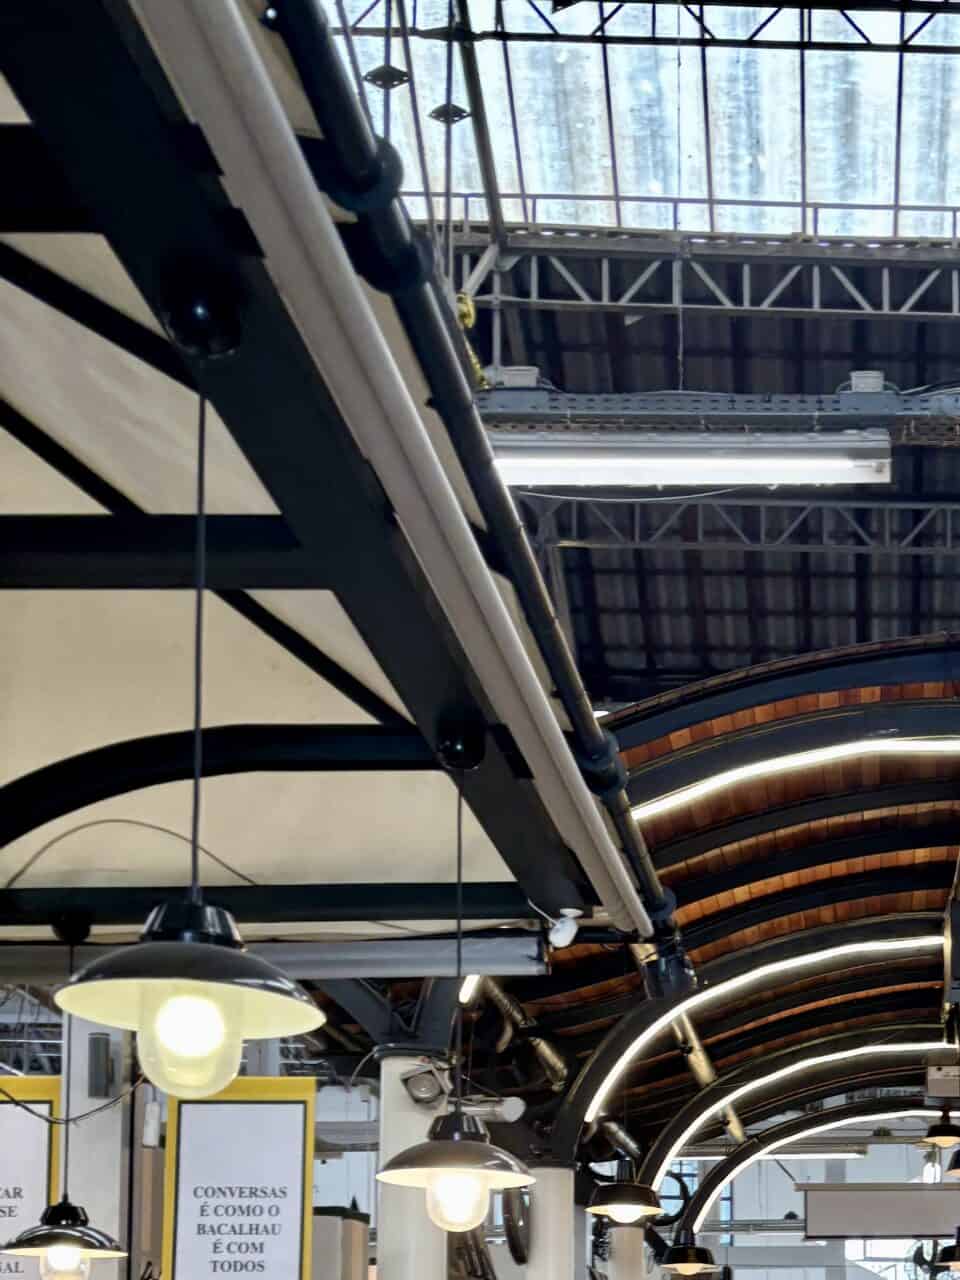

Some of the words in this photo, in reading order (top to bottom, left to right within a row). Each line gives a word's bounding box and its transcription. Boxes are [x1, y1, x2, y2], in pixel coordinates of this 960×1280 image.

[0, 1187, 24, 1200] AR
[192, 1186, 288, 1199] CONVERSAS
[200, 1201, 210, 1217] É
[213, 1204, 264, 1217] COMO
[267, 1204, 281, 1217] O
[196, 1223, 282, 1236] BACALHAU
[212, 1239, 224, 1254] É
[226, 1241, 265, 1254] COM
[0, 1261, 24, 1274] AL
[209, 1260, 265, 1273] TODOS
